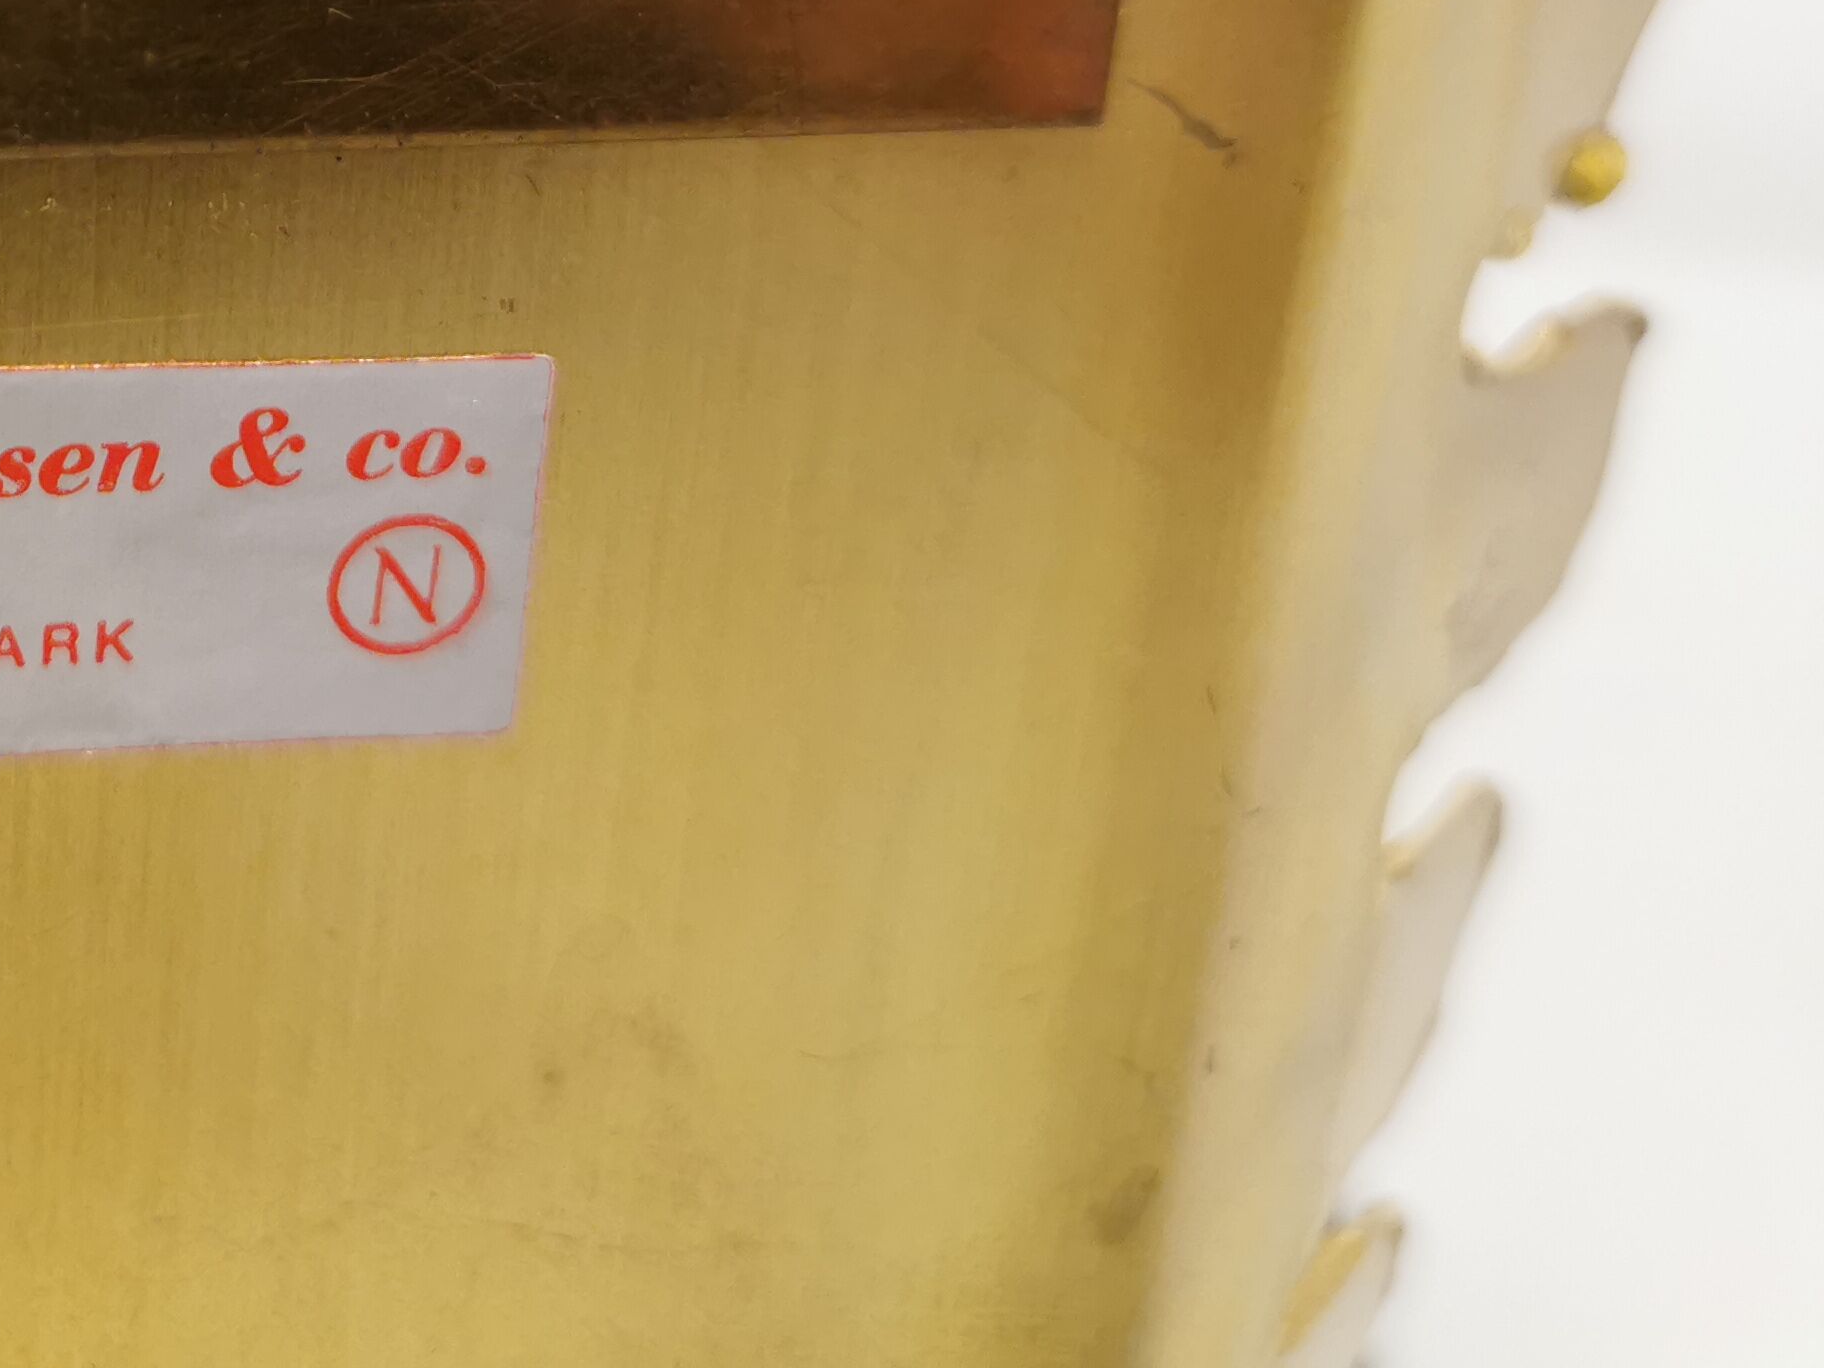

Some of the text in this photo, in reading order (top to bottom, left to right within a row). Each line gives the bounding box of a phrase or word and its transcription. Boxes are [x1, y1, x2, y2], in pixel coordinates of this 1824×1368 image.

[209, 405, 308, 491] &
[345, 422, 489, 484] co.
[370, 544, 444, 629] N
